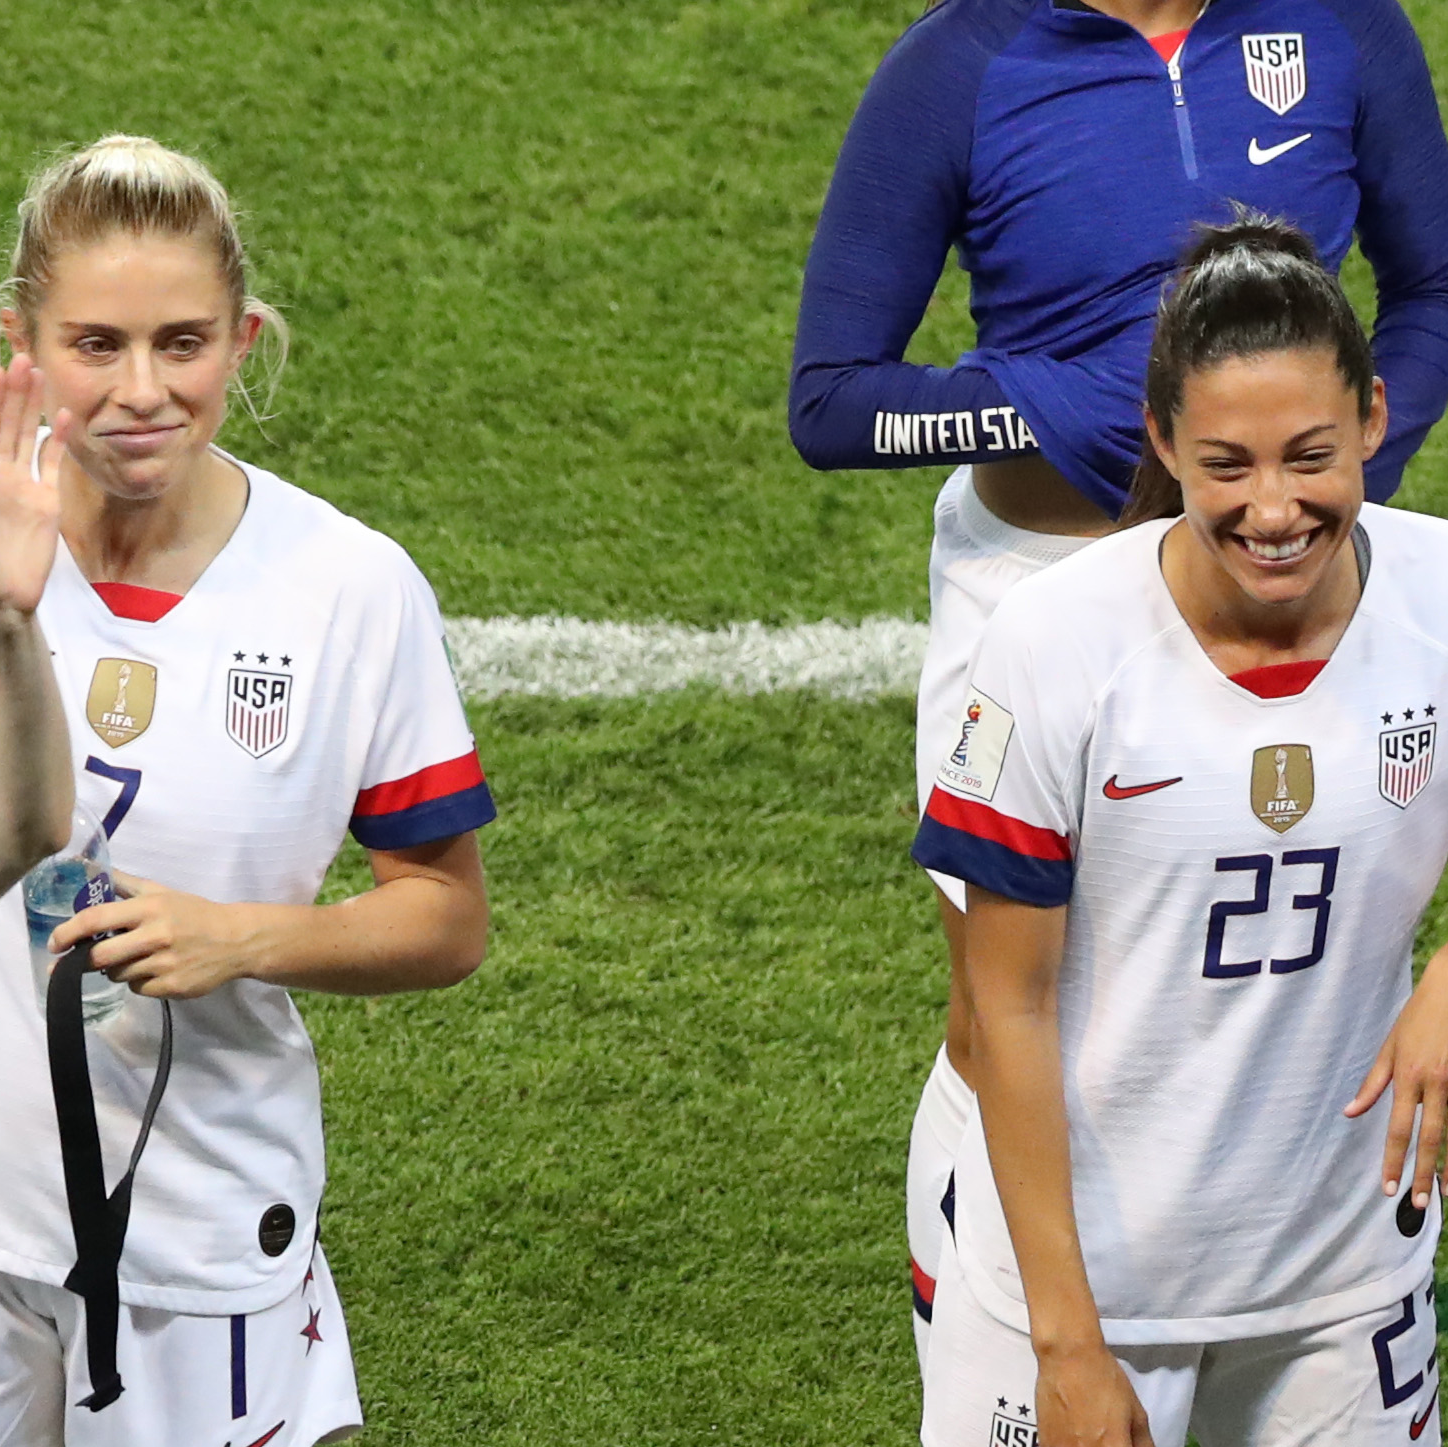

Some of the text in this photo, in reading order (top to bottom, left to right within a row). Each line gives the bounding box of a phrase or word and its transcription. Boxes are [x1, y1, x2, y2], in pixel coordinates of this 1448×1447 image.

[1248, 39, 1299, 68] USA
[874, 406, 1040, 455] UNITED STA
[234, 676, 286, 709] USA
[102, 712, 134, 728] FIFA
[1385, 729, 1431, 763] USA
[940, 764, 961, 783] NCE
[960, 775, 983, 789] 2019
[83, 755, 142, 860] 7
[1267, 799, 1298, 812] FIFA
[1202, 846, 1341, 979] 23
